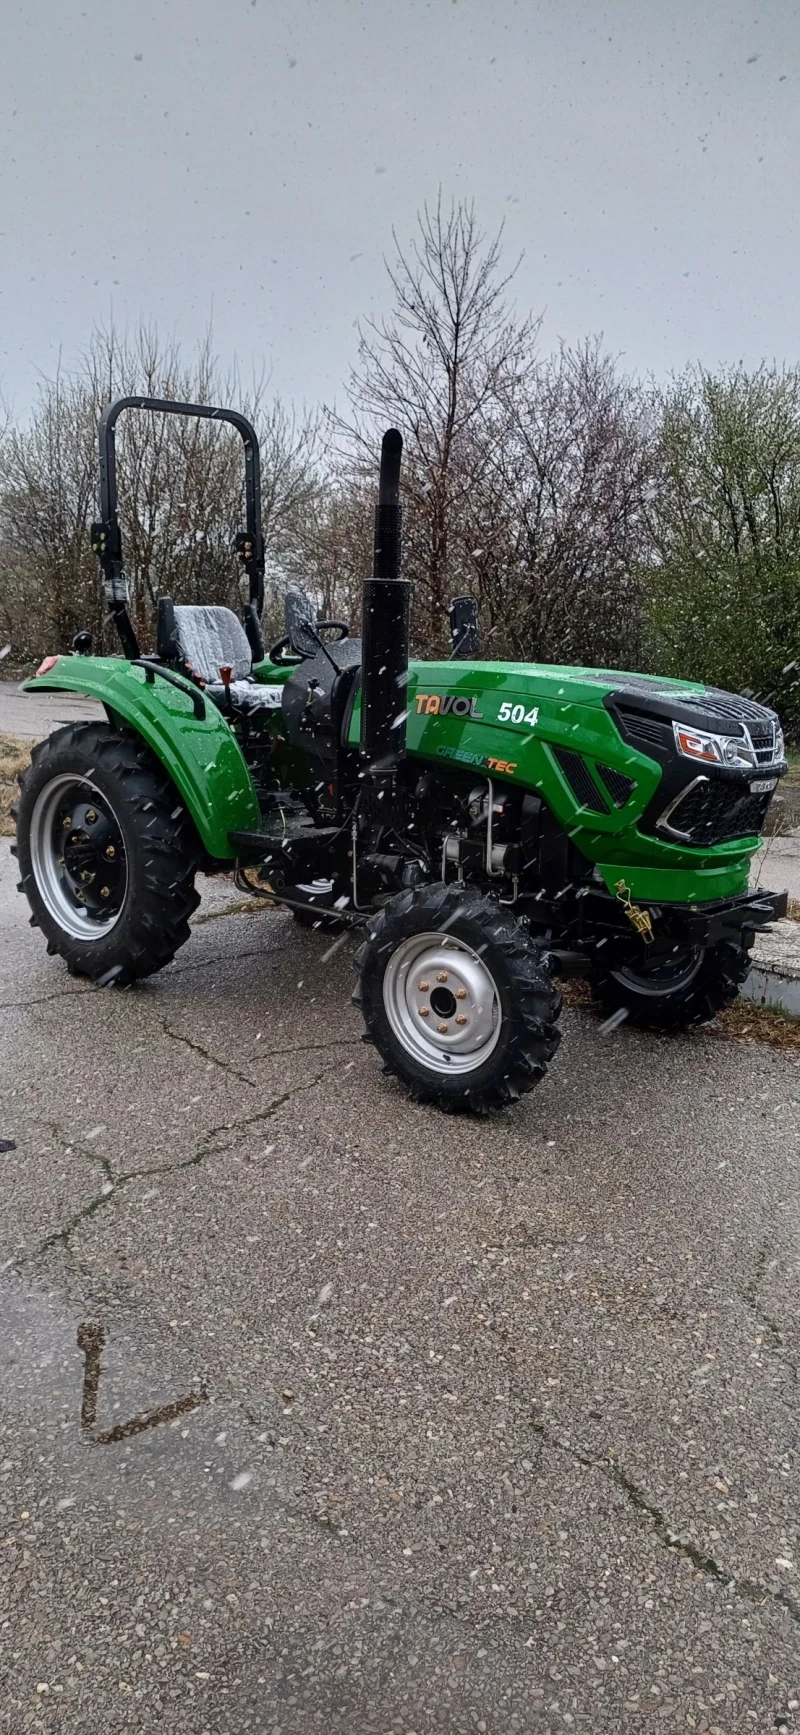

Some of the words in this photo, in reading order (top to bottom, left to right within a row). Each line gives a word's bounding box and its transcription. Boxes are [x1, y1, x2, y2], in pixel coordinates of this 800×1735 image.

[415, 694, 483, 719] TAVOL
[497, 702, 539, 727] 504
[436, 745, 483, 766] GREEN
[488, 757, 517, 775] TEC
